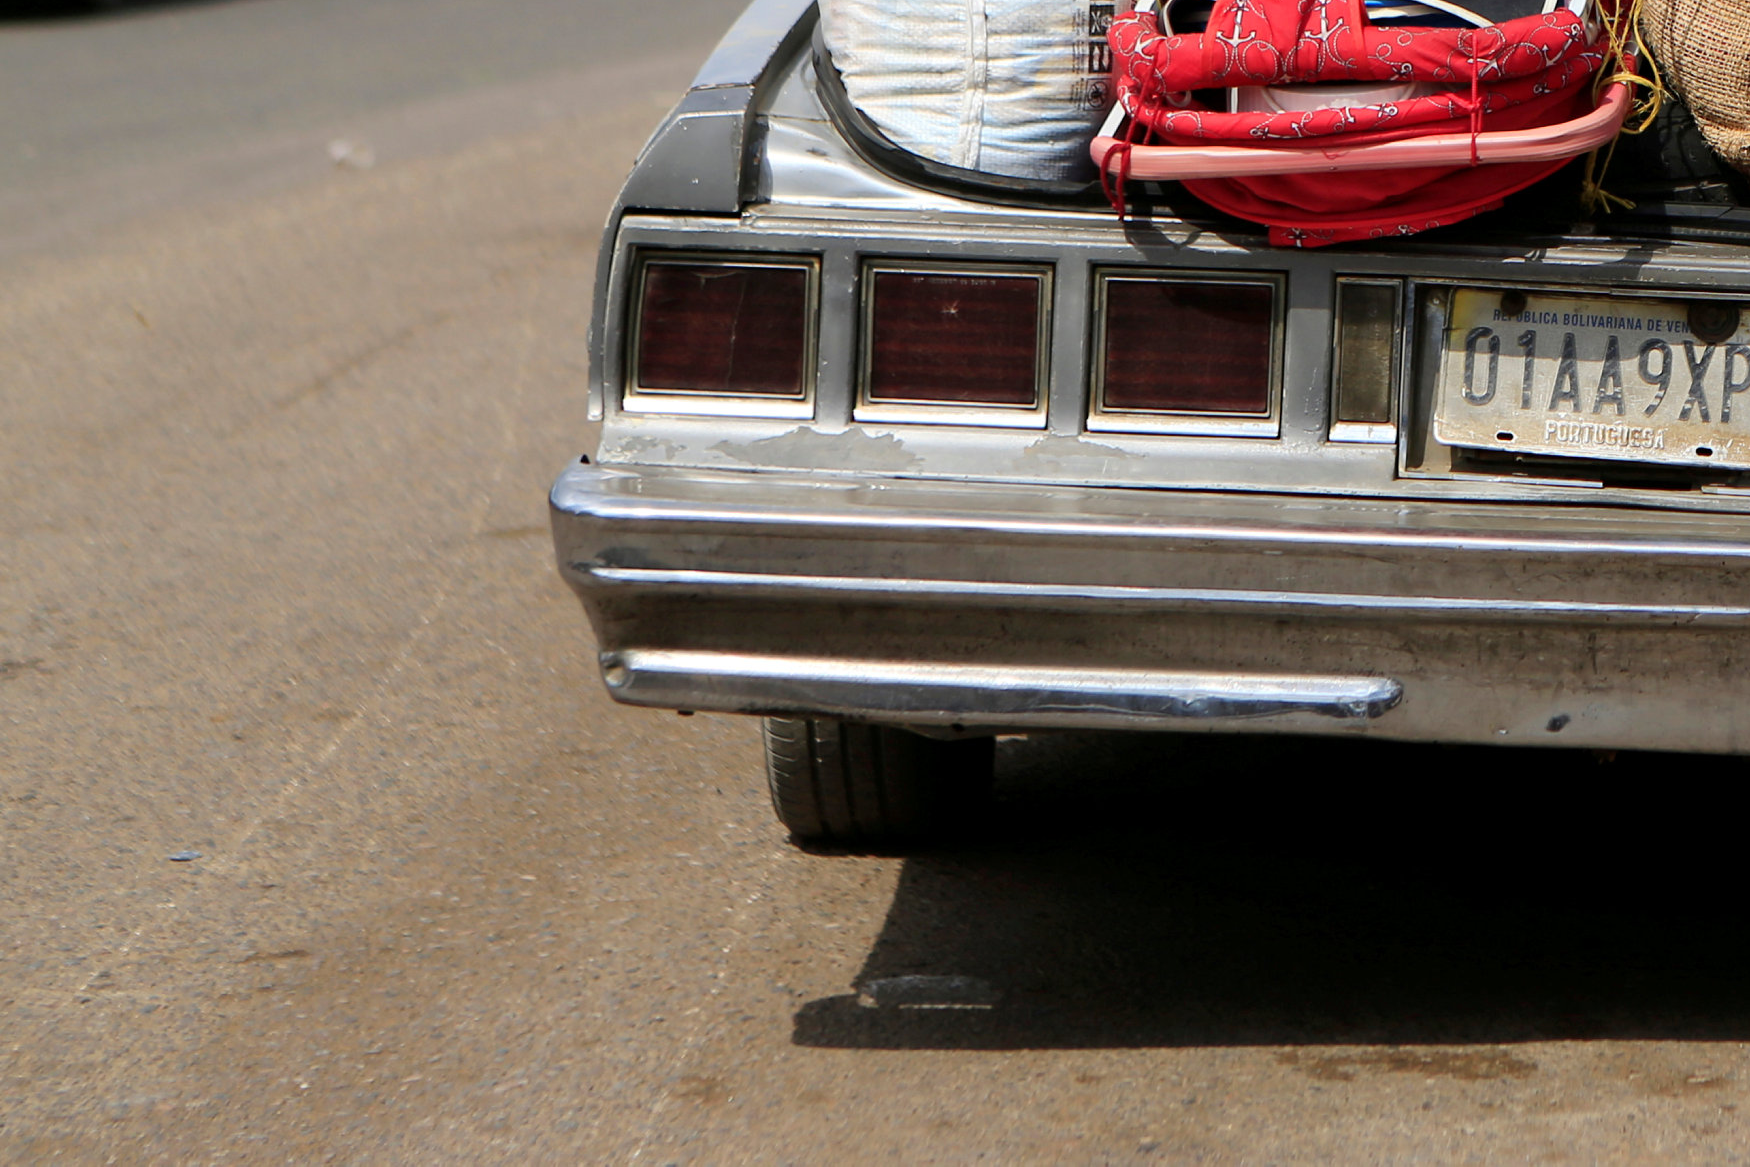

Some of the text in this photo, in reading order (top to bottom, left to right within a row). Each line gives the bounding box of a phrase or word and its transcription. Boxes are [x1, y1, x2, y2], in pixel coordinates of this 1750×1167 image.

[1563, 312, 1643, 332] BOLIVARIANA
[1646, 318, 1662, 332] DE
[1545, 419, 1668, 450] PORTUGUESA
